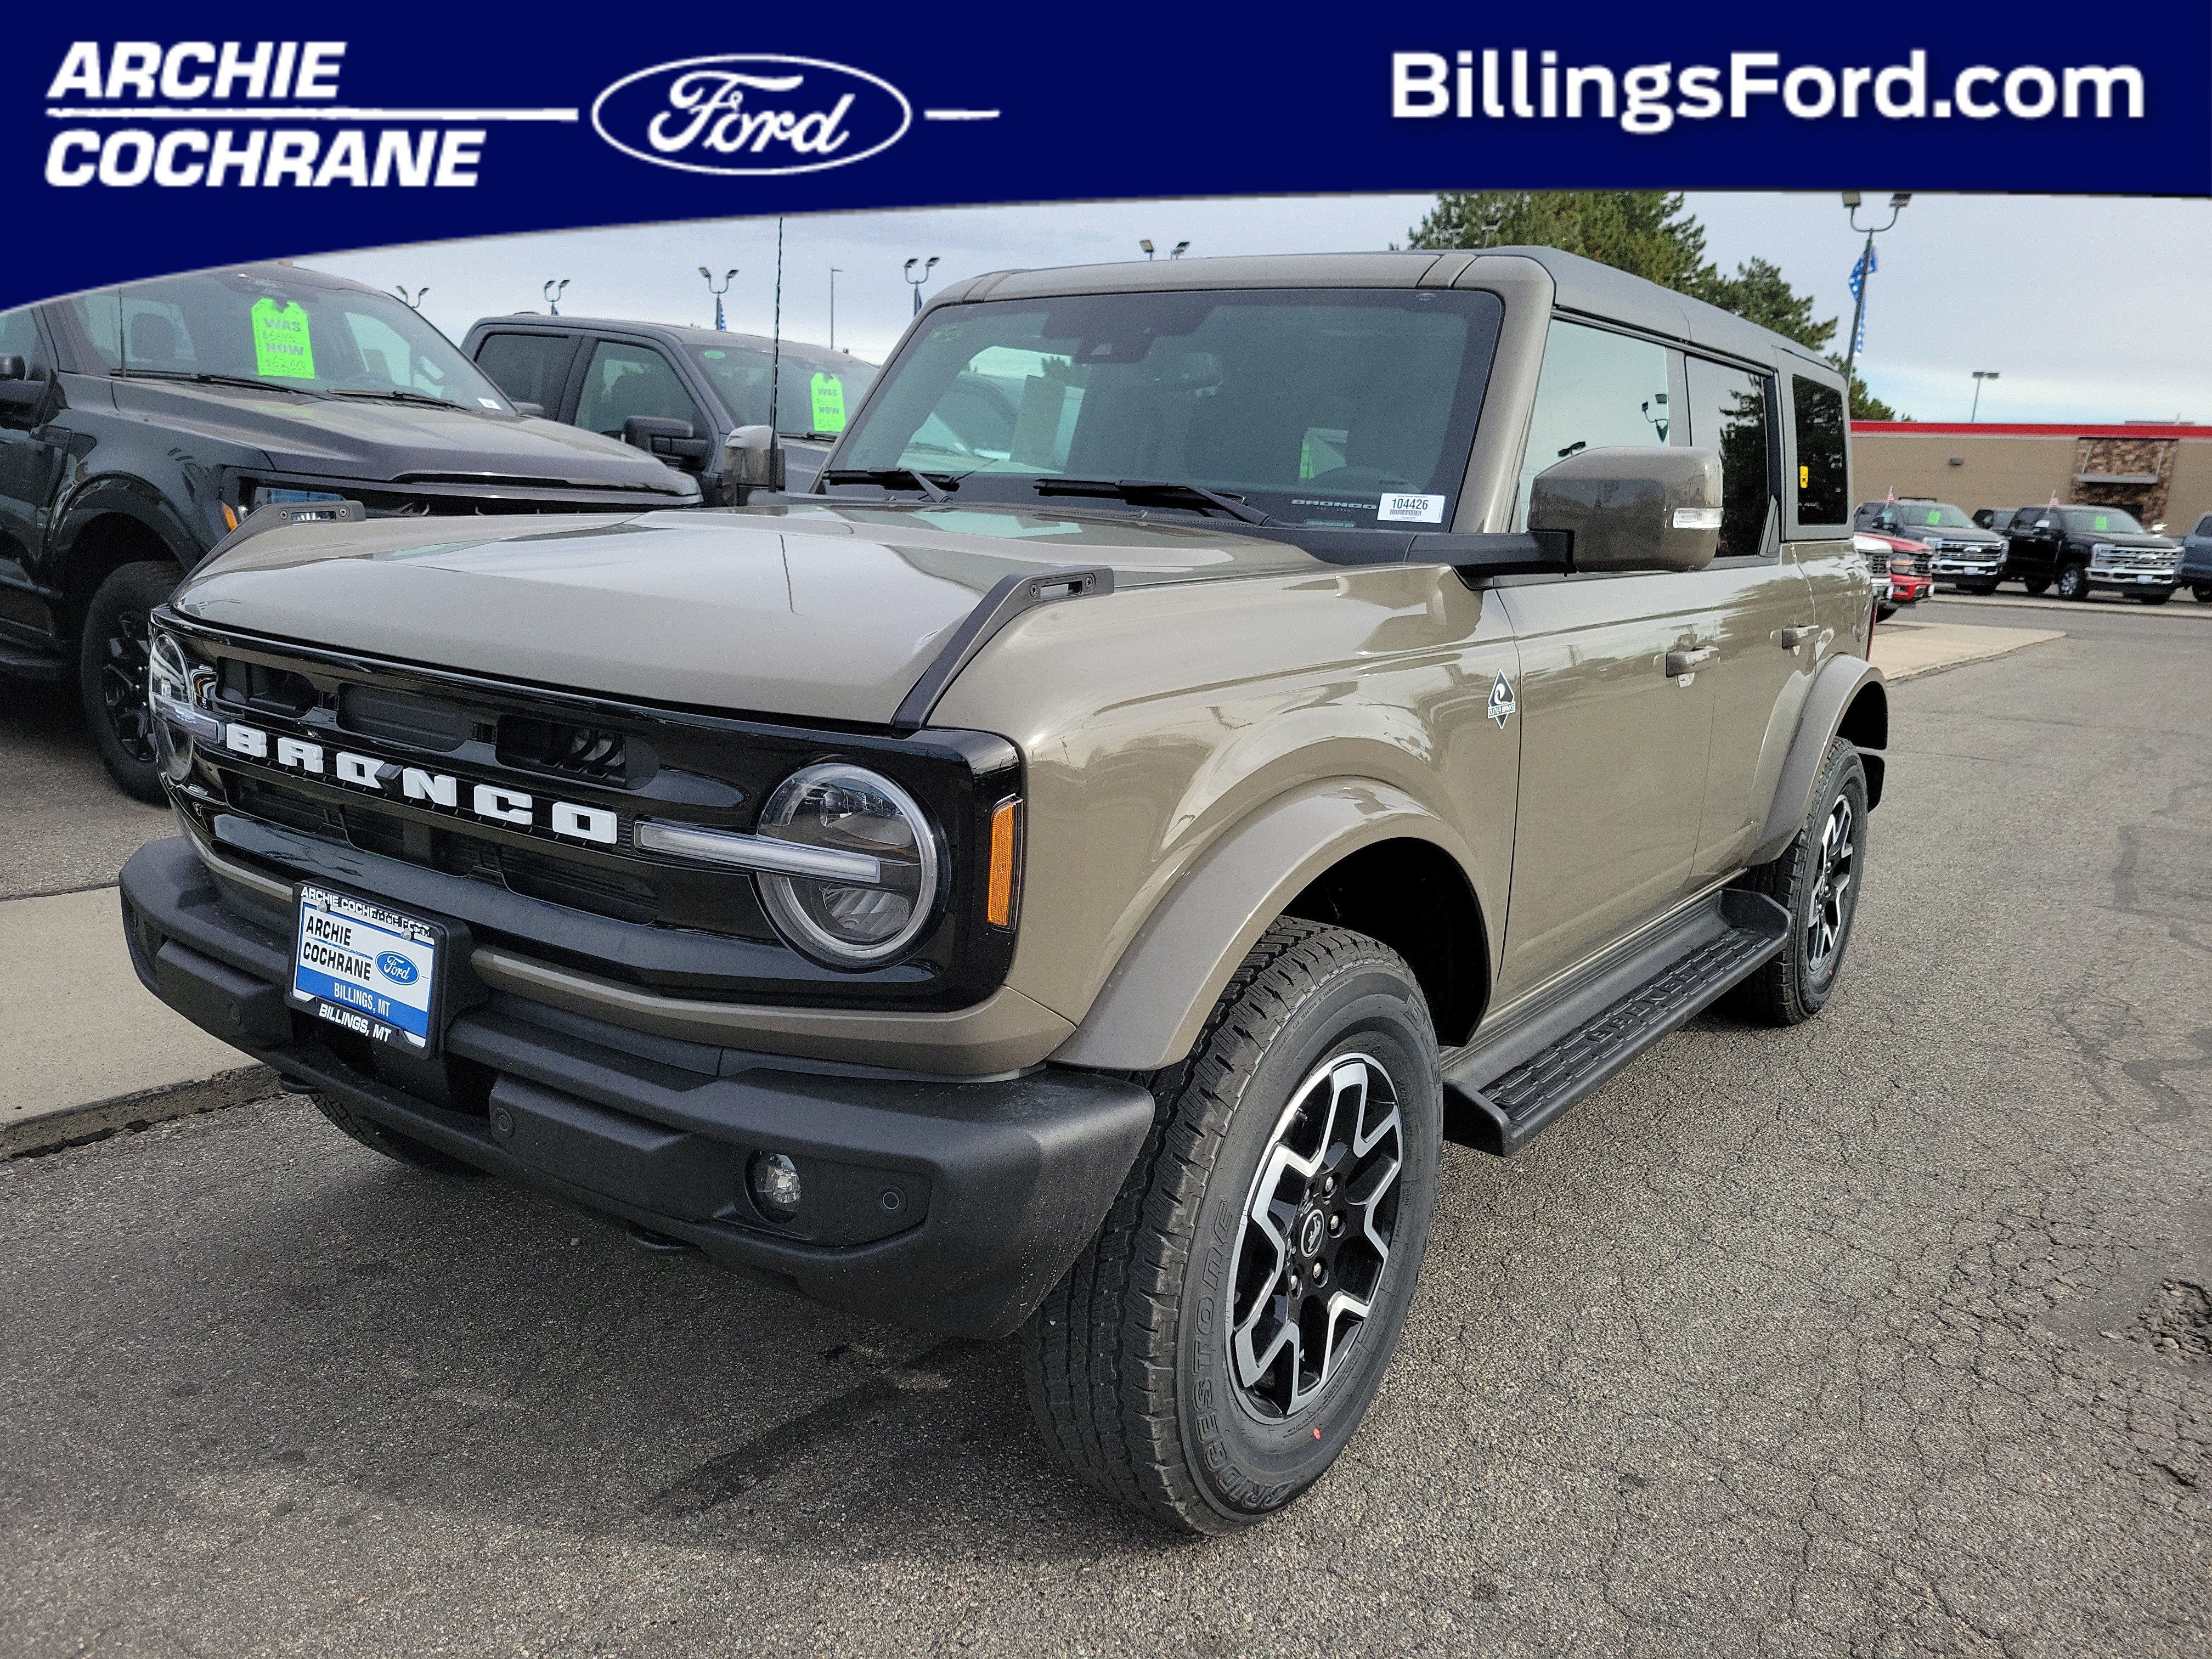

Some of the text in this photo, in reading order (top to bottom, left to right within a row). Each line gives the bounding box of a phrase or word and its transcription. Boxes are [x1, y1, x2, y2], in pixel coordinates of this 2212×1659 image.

[264, 318, 301, 332] WAS
[266, 342, 304, 356] NOW
[817, 388, 838, 397] WAS
[819, 407, 840, 415] NOW
[1291, 499, 1377, 510] BRONCO
[1392, 498, 1429, 510] 104426
[1489, 703, 1514, 716] OUTER BANKS
[226, 723, 618, 844] BRONCO
[301, 886, 338, 907] ARCHIE
[306, 916, 352, 947] ARCHIE
[303, 942, 371, 981] COCHRANE
[383, 956, 410, 980] Ford
[334, 982, 391, 1017] BILLINGS, MT
[1587, 973, 1697, 1043] BRONCO
[1301, 1002, 1317, 1019] TRACTION
[319, 1003, 392, 1042] BILLINGS, MT
[1192, 1196, 1296, 1508] BRIDGESTONE
